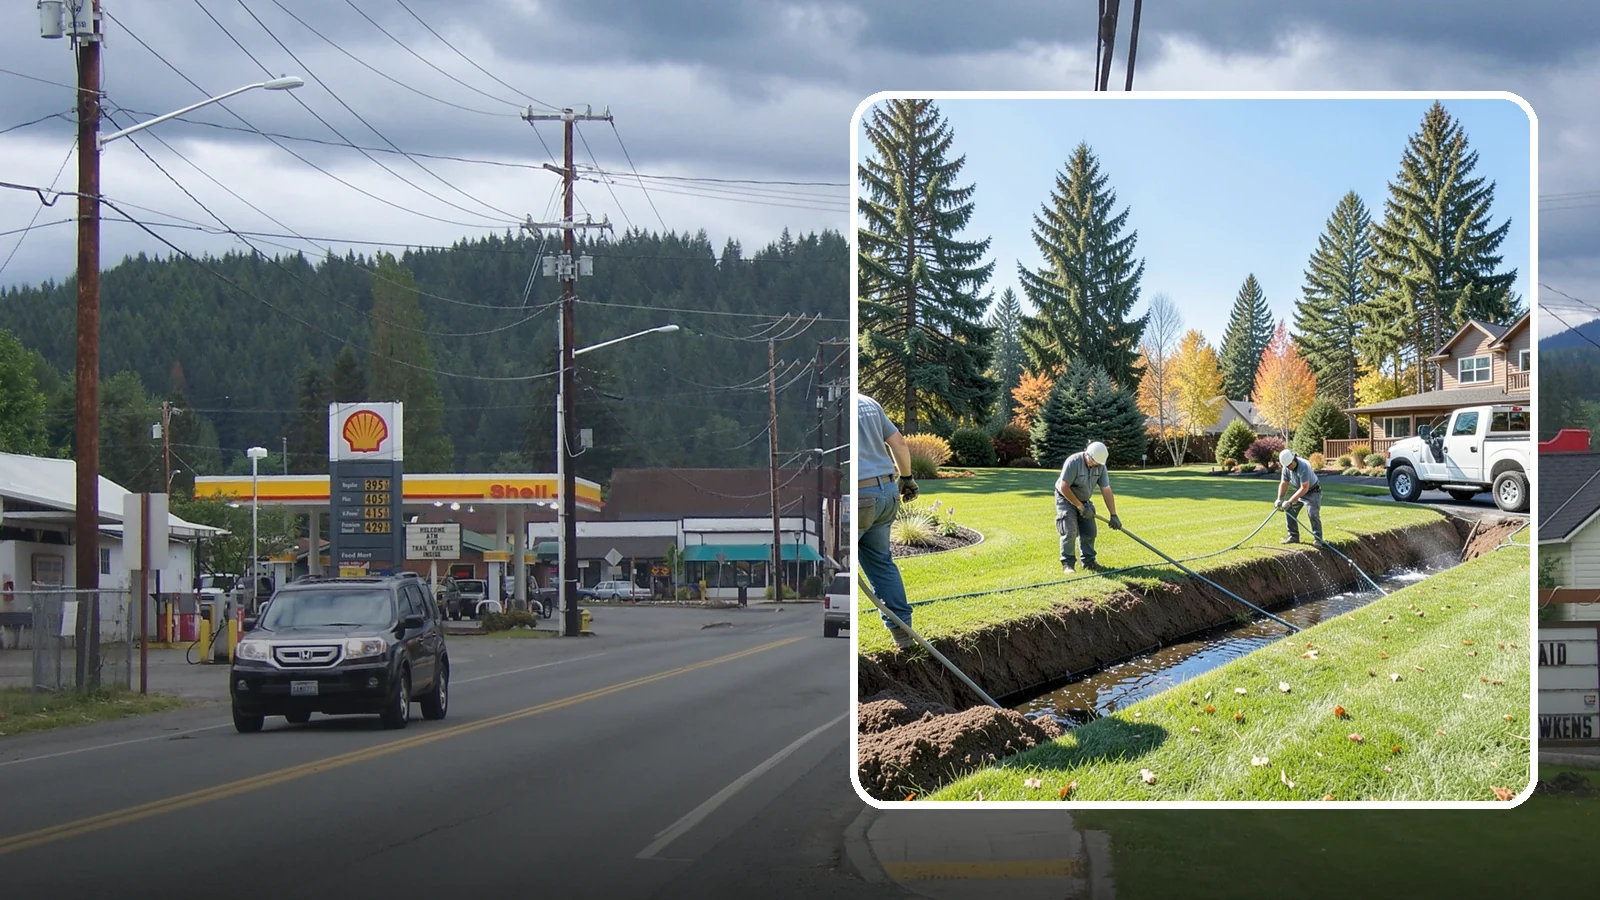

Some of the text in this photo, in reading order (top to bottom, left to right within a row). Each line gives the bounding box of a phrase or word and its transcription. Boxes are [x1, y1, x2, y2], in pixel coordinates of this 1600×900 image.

[366, 480, 383, 490] 395
[490, 484, 547, 499] Shell
[366, 494, 383, 504] 405
[366, 508, 383, 518] 415
[366, 522, 383, 532] 429
[1539, 643, 1566, 665] AID
